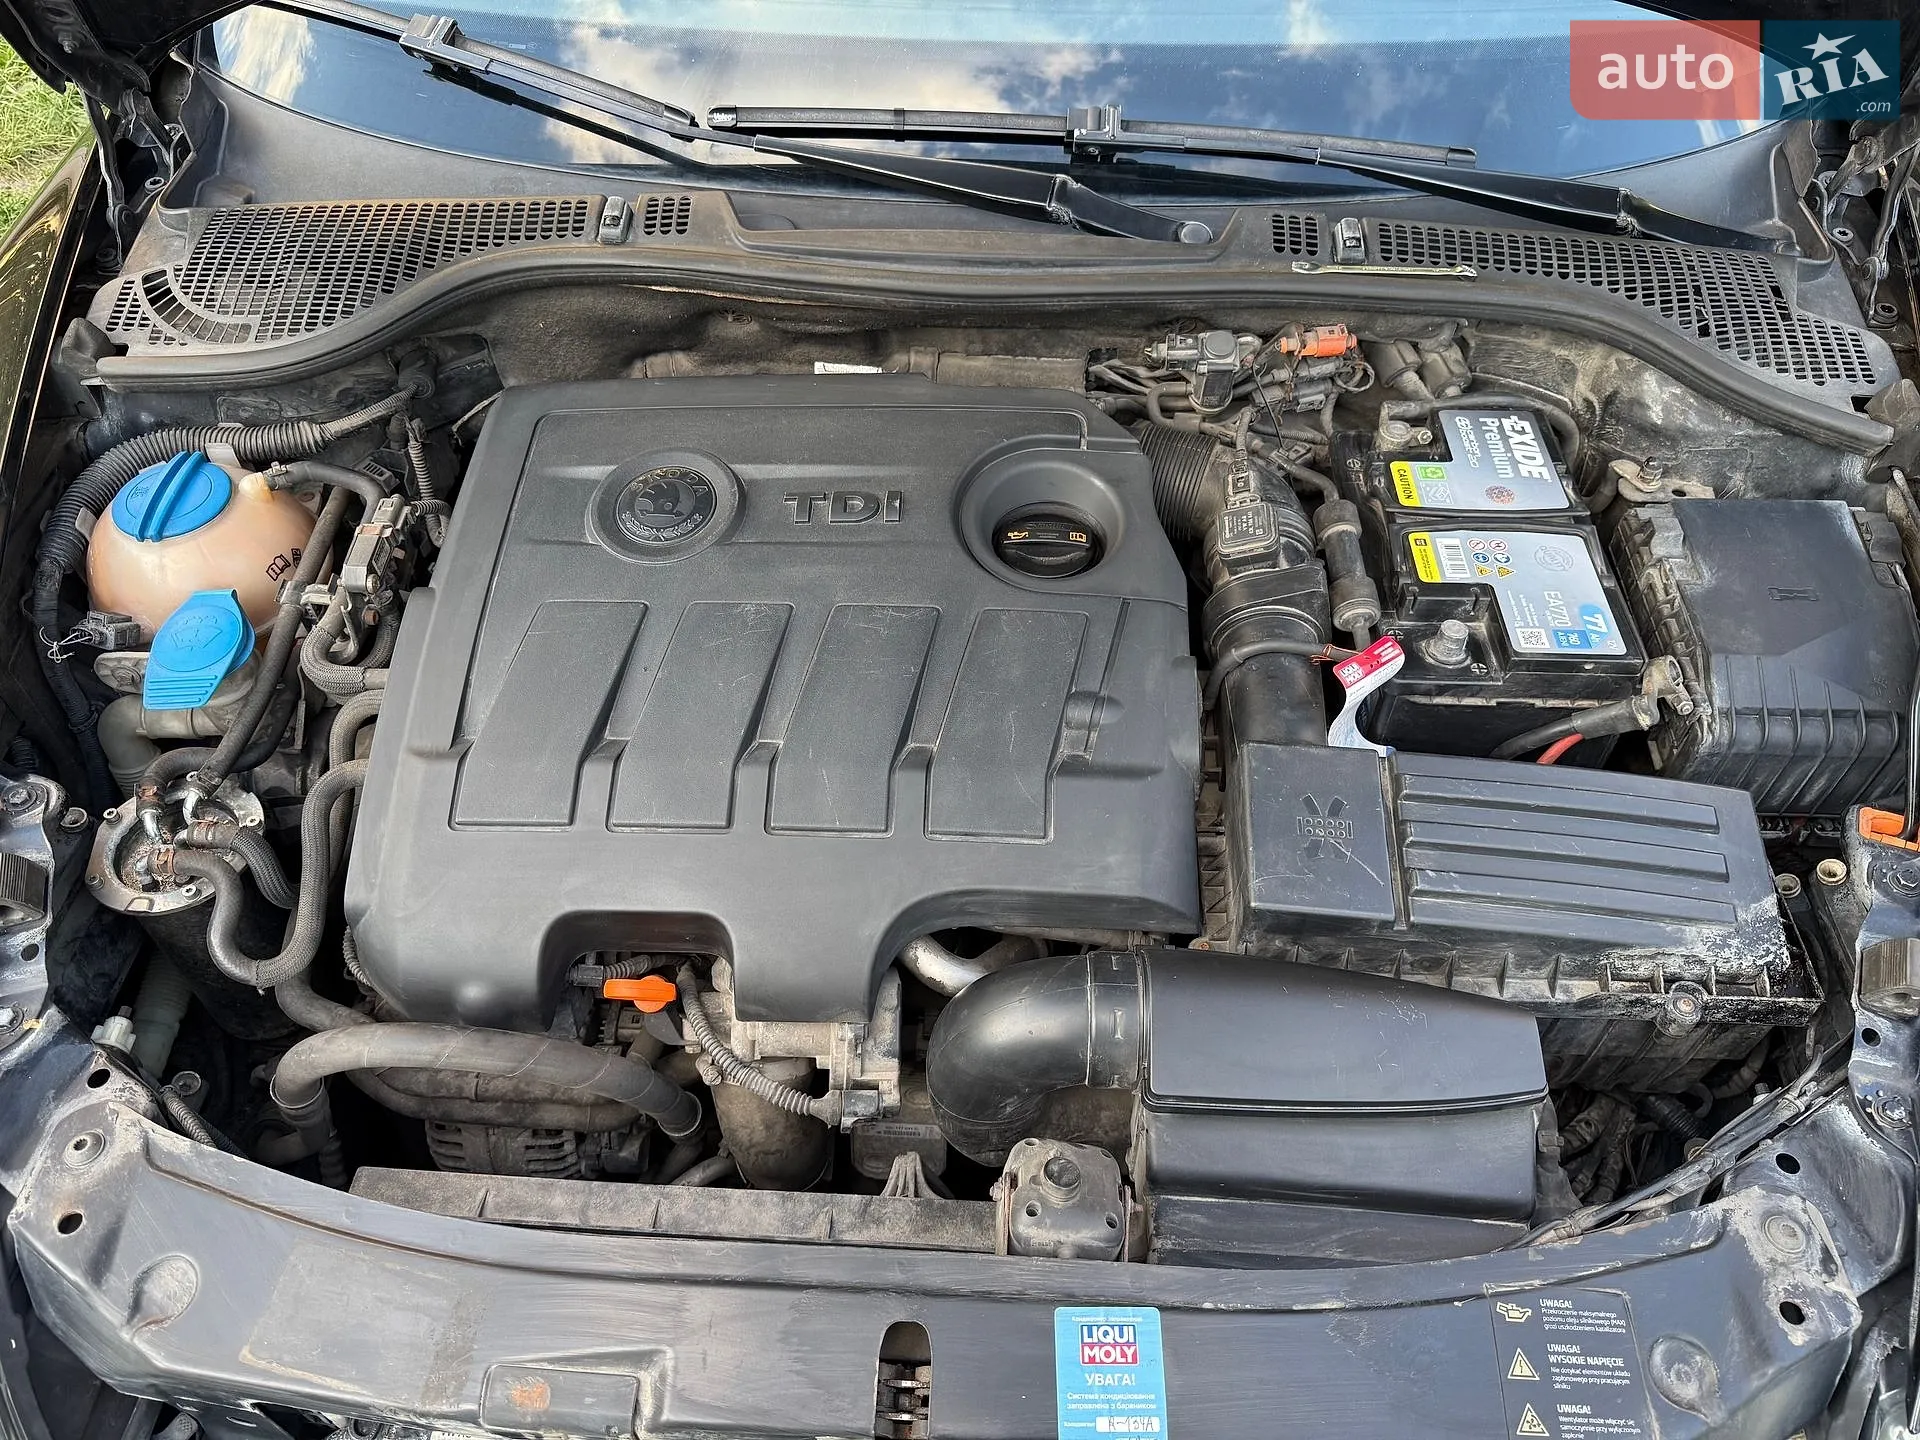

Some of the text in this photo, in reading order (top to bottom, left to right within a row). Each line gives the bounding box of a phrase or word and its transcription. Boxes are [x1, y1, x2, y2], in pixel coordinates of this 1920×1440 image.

[1479, 417, 1514, 479] Premium
[1501, 415, 1551, 481] EXIDE
[1397, 468, 1414, 500] CAUTION
[783, 489, 903, 525] TDI
[1544, 591, 1573, 627] EA770
[1583, 613, 1609, 633] 77
[1540, 1299, 1572, 1309] UWAGA!
[1082, 1325, 1135, 1343] LIQUI
[1083, 1345, 1136, 1363] MOLY
[1547, 1343, 1580, 1353] UWAGA!
[1548, 1354, 1624, 1368] WYSOKIE NAPIĘCIE
[1085, 1373, 1136, 1386] УВАГА!
[1067, 1392, 1099, 1400] Система
[1557, 1404, 1591, 1414] UWAGA!
